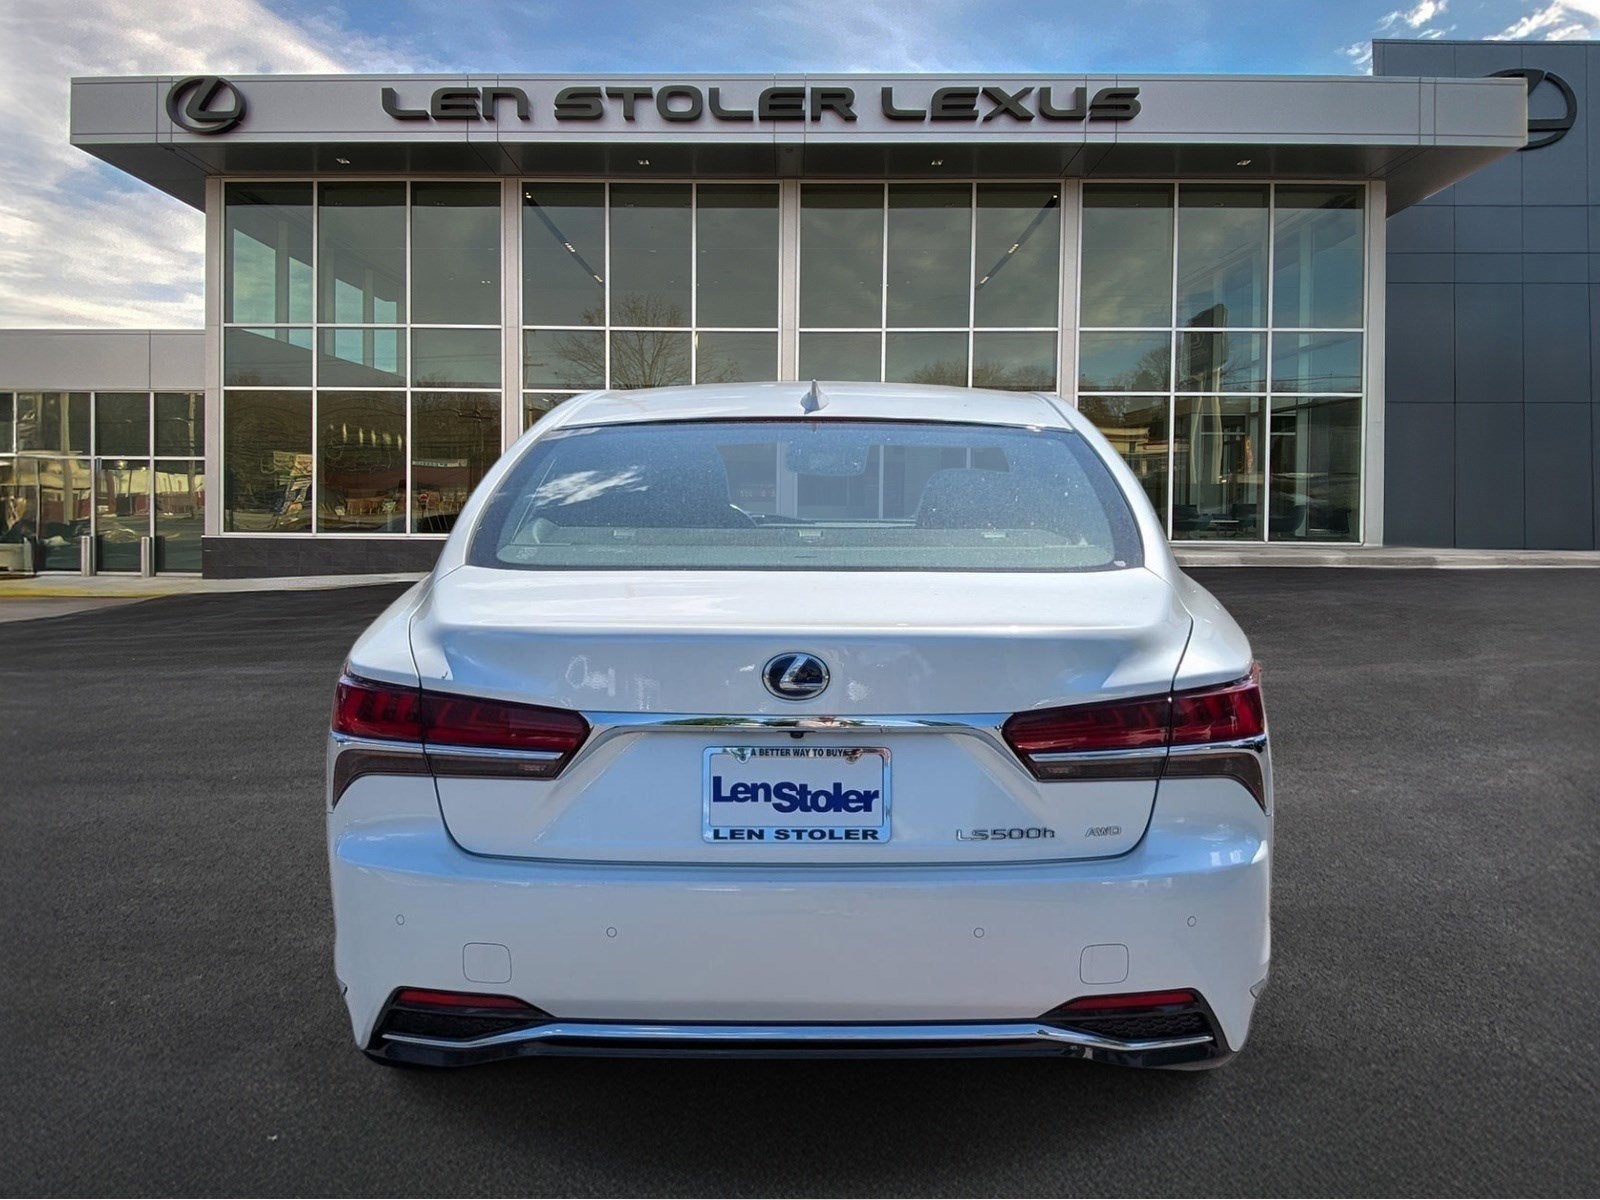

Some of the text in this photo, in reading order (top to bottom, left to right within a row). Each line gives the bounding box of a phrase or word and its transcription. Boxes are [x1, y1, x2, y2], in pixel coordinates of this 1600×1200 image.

[381, 85, 1142, 122] LEN STOLER LEXUS
[751, 748, 757, 757] A
[759, 748, 791, 757] BETTER
[792, 748, 811, 757] WAY
[813, 748, 824, 757] TO
[713, 829, 879, 840] LEN STOLER
[1084, 826, 1122, 837] AWD
